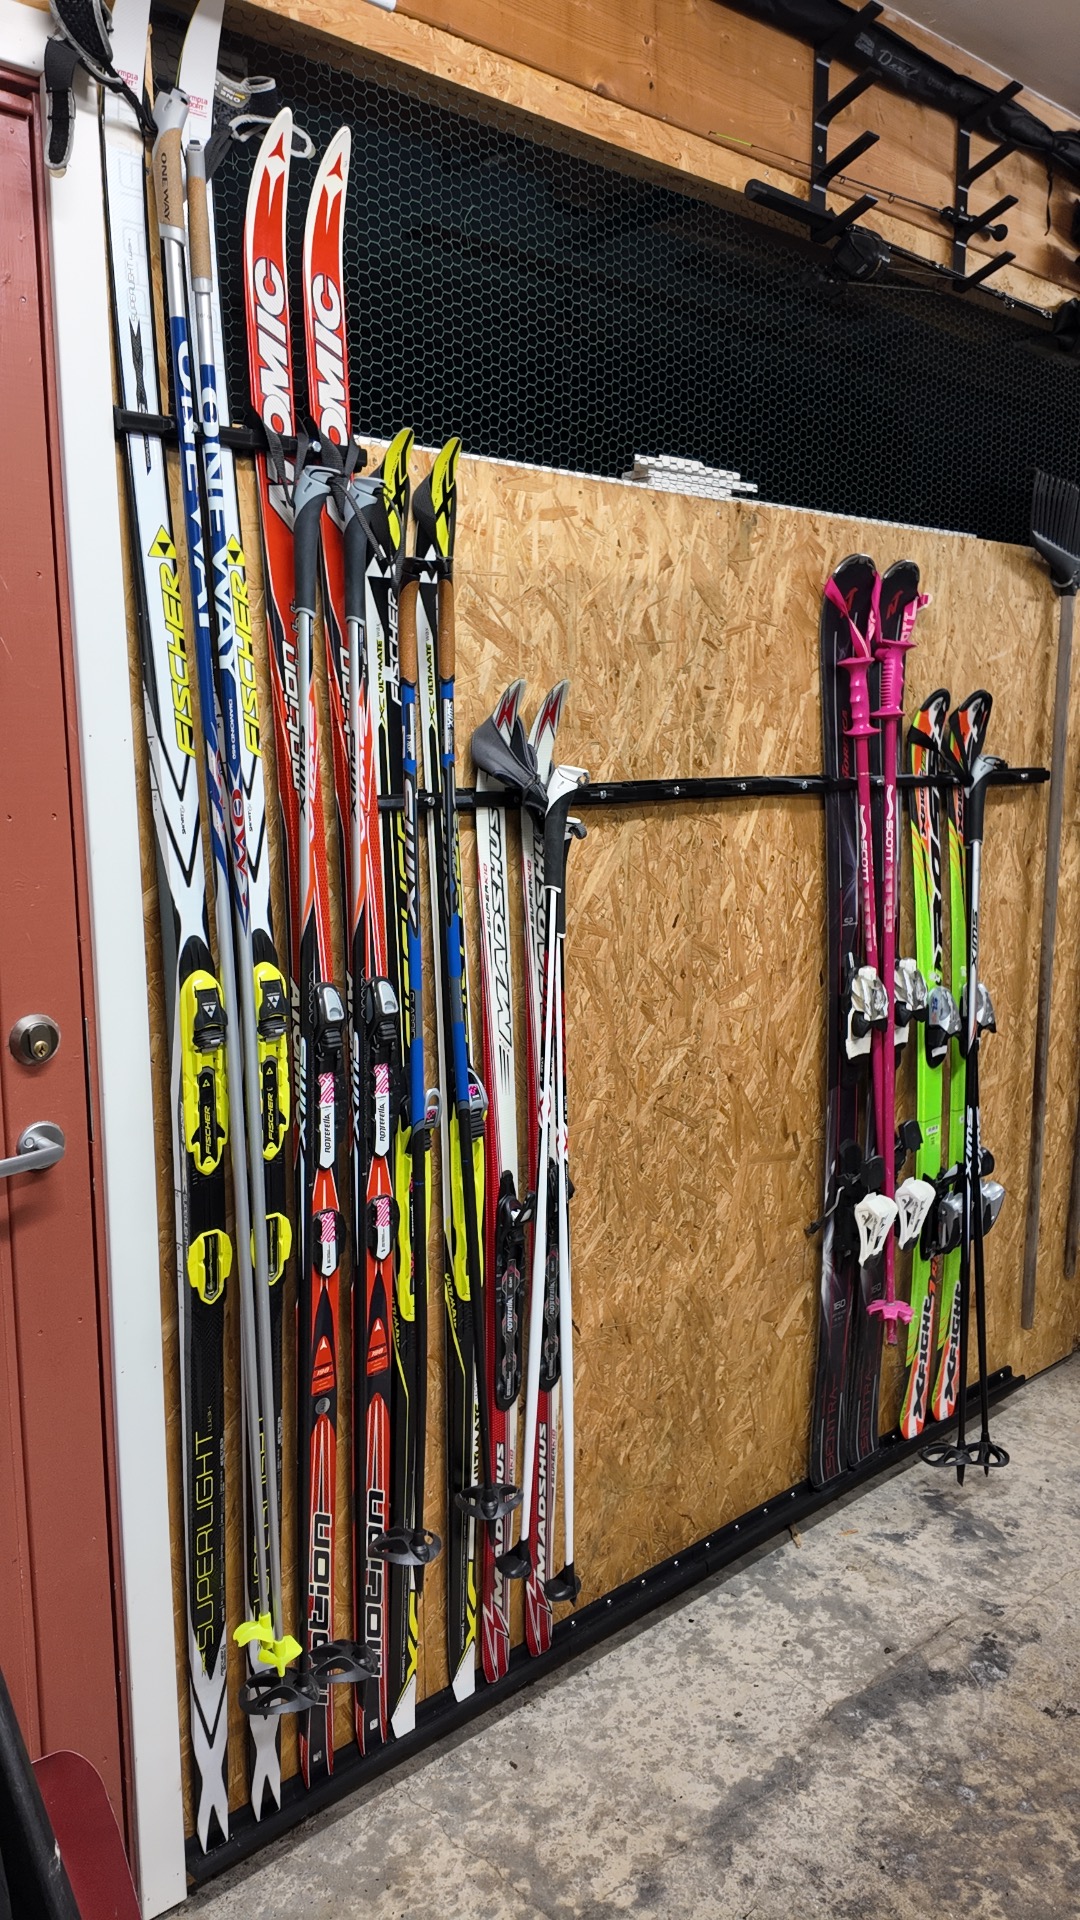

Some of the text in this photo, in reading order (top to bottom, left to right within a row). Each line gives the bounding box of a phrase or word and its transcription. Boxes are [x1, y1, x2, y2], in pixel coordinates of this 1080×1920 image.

[117, 69, 138, 81] ympia
[188, 94, 208, 106] ympia
[163, 188, 171, 221] WAY
[310, 272, 350, 448] OMIC
[202, 386, 238, 688] ONE WAY
[159, 562, 196, 758] FISCHER
[230, 569, 262, 758] FISCHER
[377, 639, 385, 694] ULTIMATE
[426, 643, 434, 697] ULTIMATE
[228, 698, 237, 745] DIAMOND
[861, 840, 870, 883] SCOTT
[886, 819, 894, 864] SCOTT
[483, 862, 491, 931] SUPERKID
[527, 858, 535, 927] SUPERKID
[489, 807, 513, 1048] MADSHUS
[970, 909, 978, 969] SWIX
[965, 1105, 974, 1176] SWIX
[535, 1421, 549, 1590] MADSHUS
[196, 1431, 214, 1651] SUPERLIGHT
